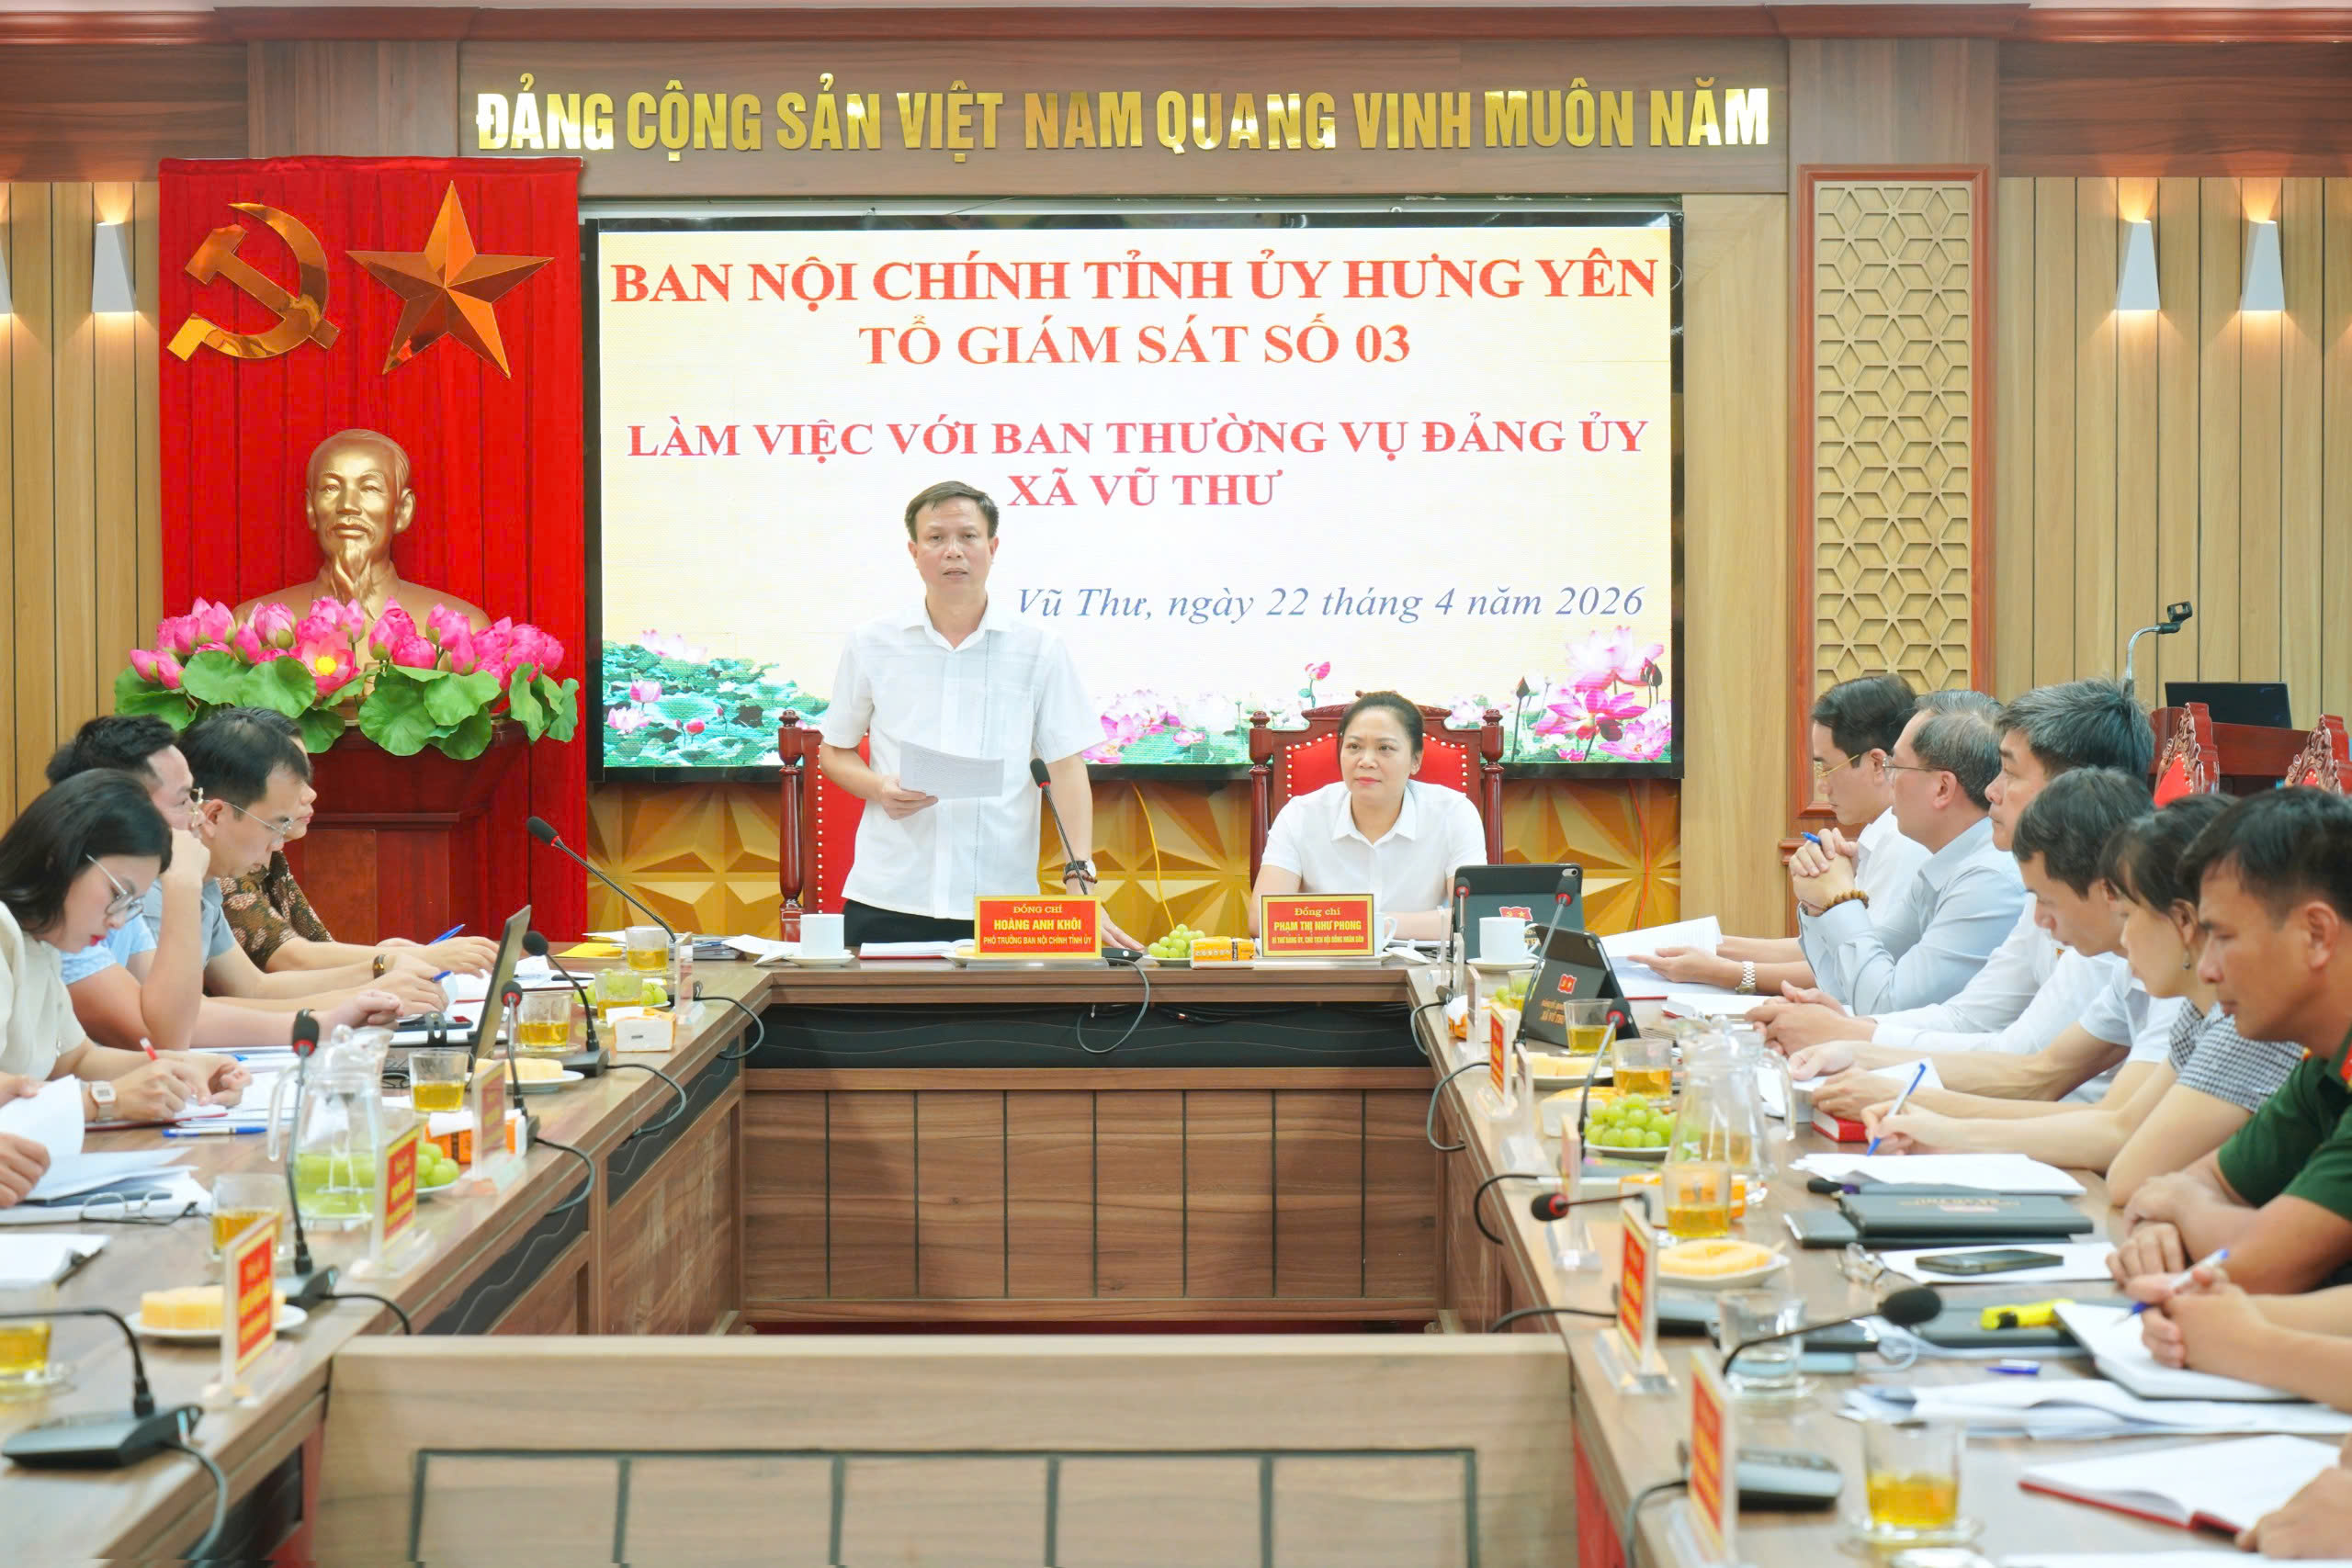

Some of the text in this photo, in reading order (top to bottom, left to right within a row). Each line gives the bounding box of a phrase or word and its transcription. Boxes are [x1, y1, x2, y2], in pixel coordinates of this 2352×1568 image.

[476, 73, 1770, 164] ĐẢNG CỘNG SẢN VIỆT NAM QUANG VINH MUÔN NĂM
[612, 248, 1657, 313] BAN NỘI CHÍNH TỈNH ỦY HƯNG YÊN
[860, 312, 1411, 366] TỔ GIÁM SÁT SỐ 03
[627, 411, 1647, 465] LÀM VIỆC VỚI BAN THƯỜNG VỤ ĐẢNG ỦY
[1011, 468, 1283, 507] XÃ VŨ THƯ
[1016, 588, 1644, 626] Vũ Thư, ngày 22 tháng 4 năm 2026
[994, 918, 1082, 931] HOÀNG ANH KHÔI
[1013, 904, 1063, 914] ĐỒNG CHÍ
[1273, 919, 1363, 933] PHẠM THỊ NHƯ PHONG
[1294, 906, 1341, 917] Đồng chí
[983, 935, 997, 945] PHÓ
[1023, 936, 1036, 945] BAN
[1048, 934, 1068, 945] CHÍNH
